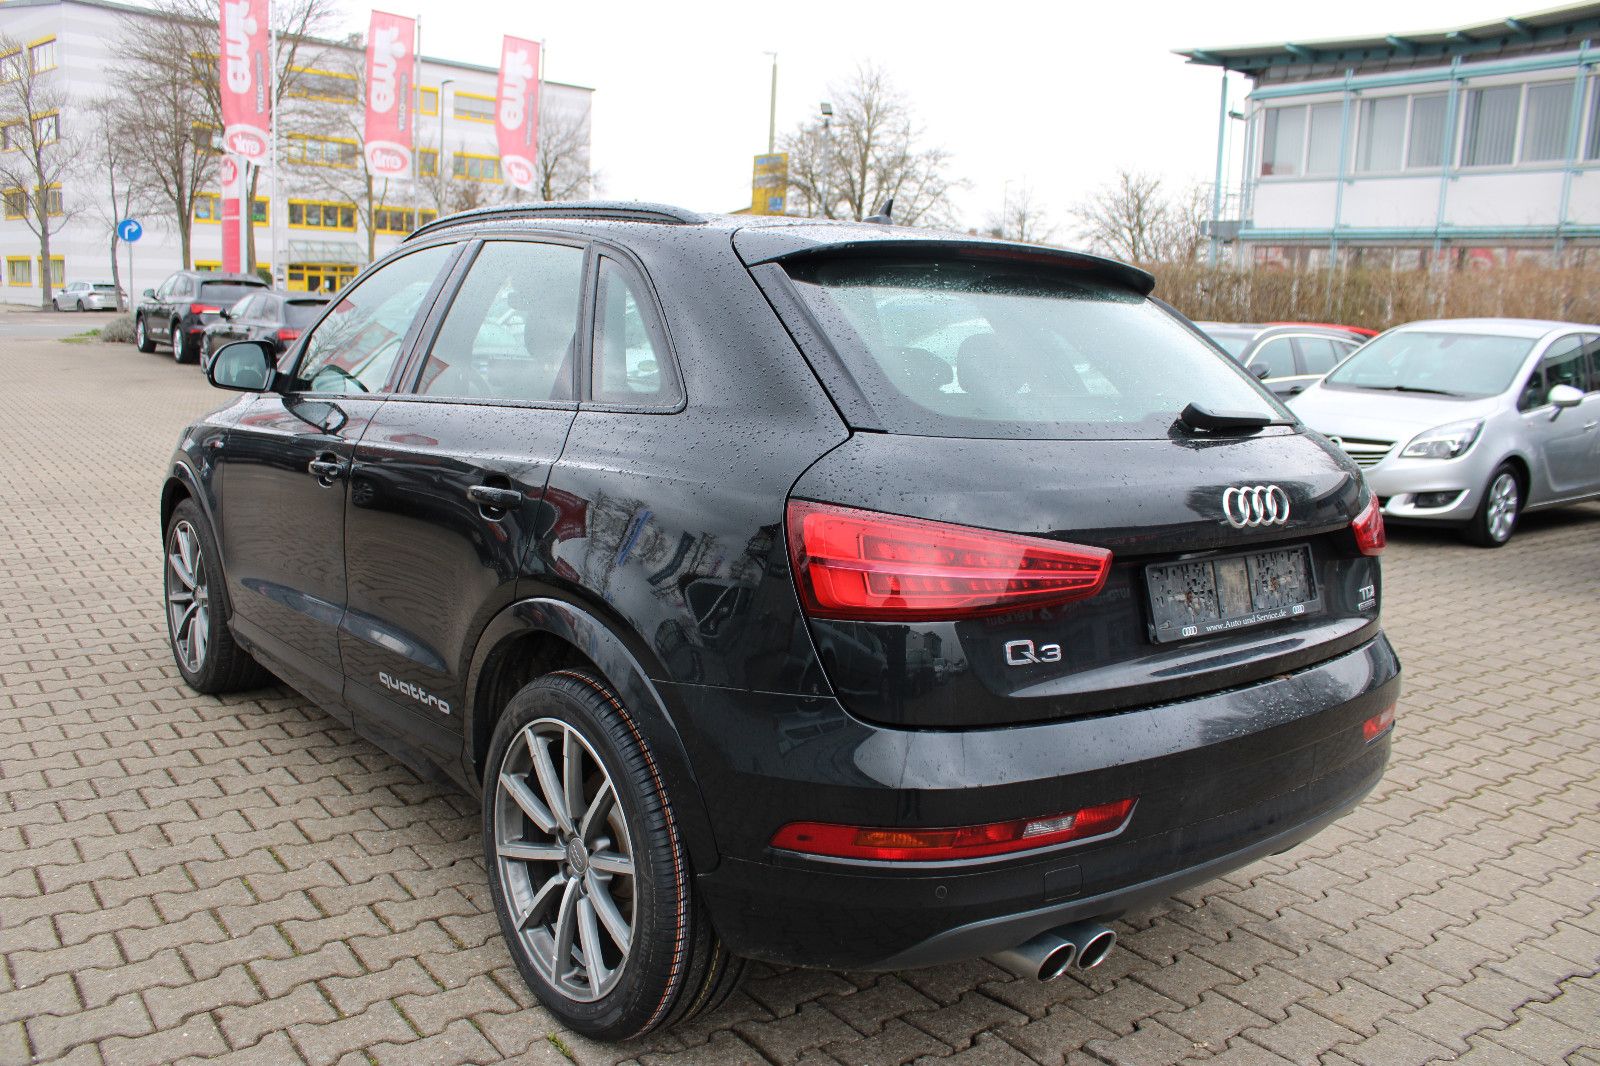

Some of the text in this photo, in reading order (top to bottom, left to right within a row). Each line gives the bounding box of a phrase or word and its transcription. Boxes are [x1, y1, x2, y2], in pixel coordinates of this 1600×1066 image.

[1242, 615, 1256, 626] und
[1005, 640, 1062, 666] Q3
[379, 671, 450, 715] quattro
